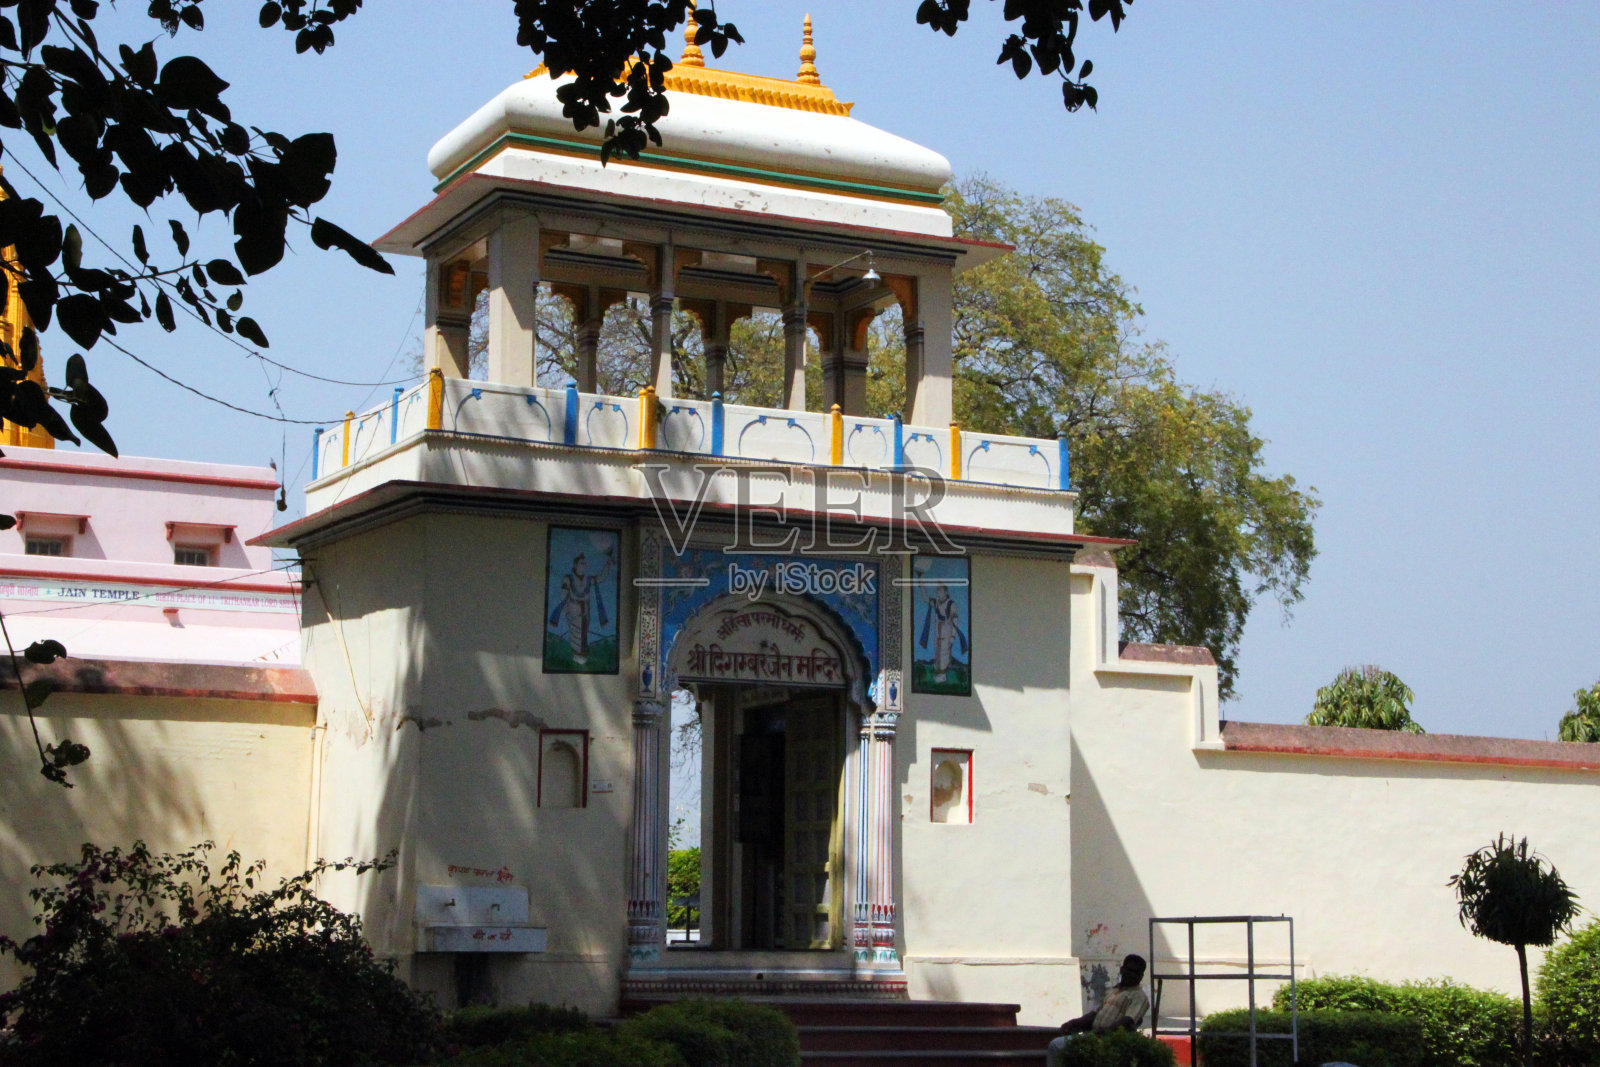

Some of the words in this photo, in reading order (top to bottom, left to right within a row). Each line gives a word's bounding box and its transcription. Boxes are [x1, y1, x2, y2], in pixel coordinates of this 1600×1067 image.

[57, 587, 87, 598] JAIN
[91, 588, 140, 600] TEMPLE
[687, 643, 706, 675] श्री
[709, 643, 769, 677] दिगम्बर
[767, 643, 793, 679] जैन
[797, 648, 842, 682] मन्दिर
